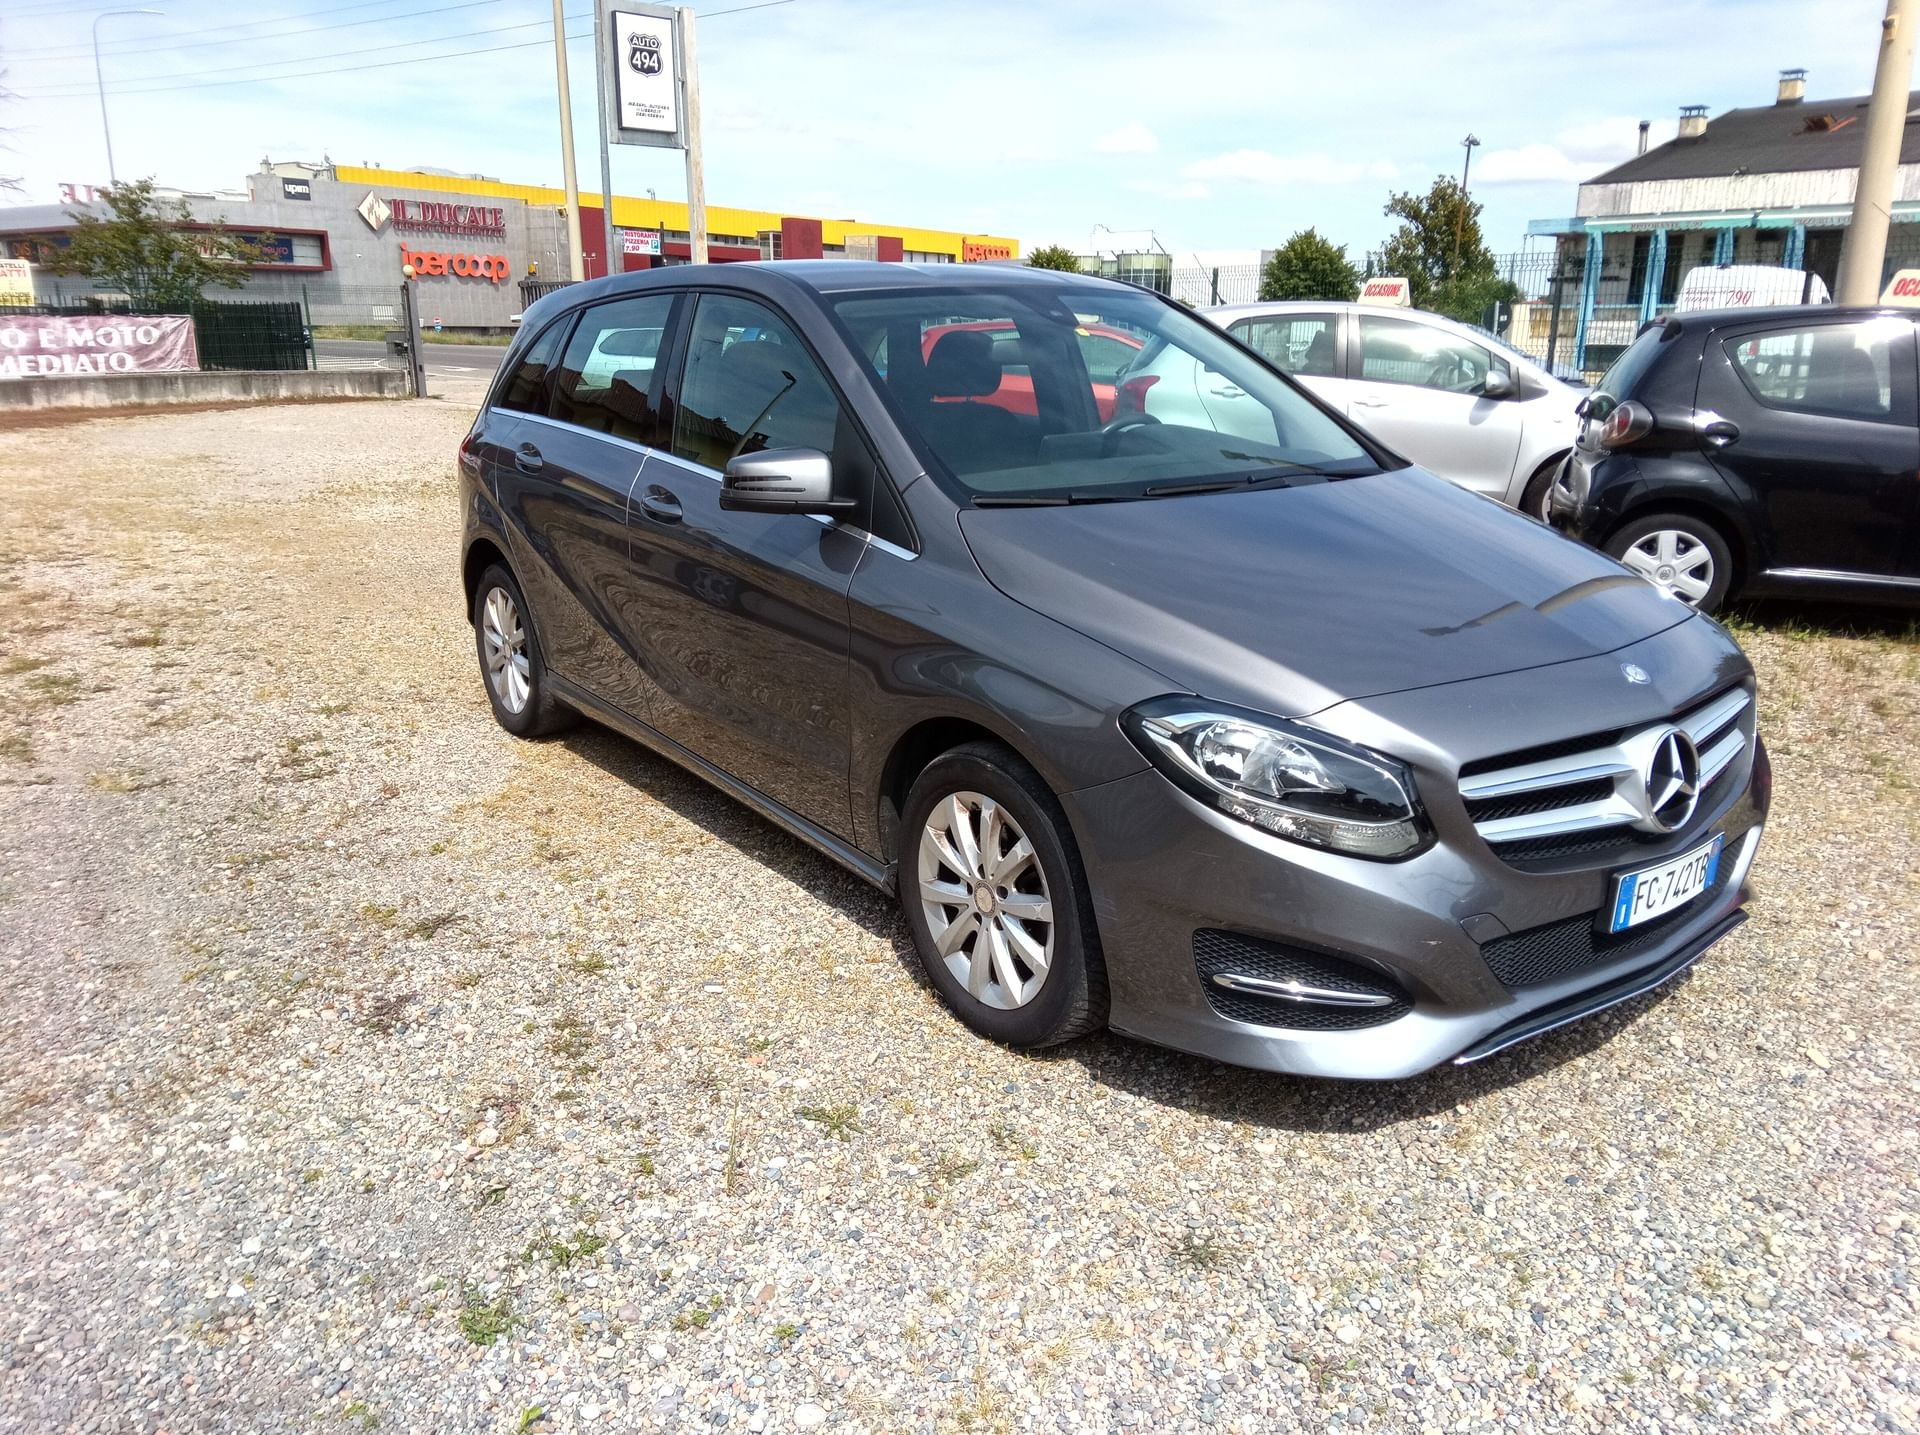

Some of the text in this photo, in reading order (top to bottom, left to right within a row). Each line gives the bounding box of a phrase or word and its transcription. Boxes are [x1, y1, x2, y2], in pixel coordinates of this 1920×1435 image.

[632, 36, 658, 48] AUTO
[632, 51, 659, 71] 494
[284, 183, 310, 195] upim
[419, 201, 506, 228] DUCALE
[624, 231, 659, 239] RISTORANTE
[624, 238, 650, 247] PIZZERIA
[399, 240, 510, 284] ipercoop
[1364, 283, 1403, 297] OCCASIONE
[66, 326, 160, 347] MOTO
